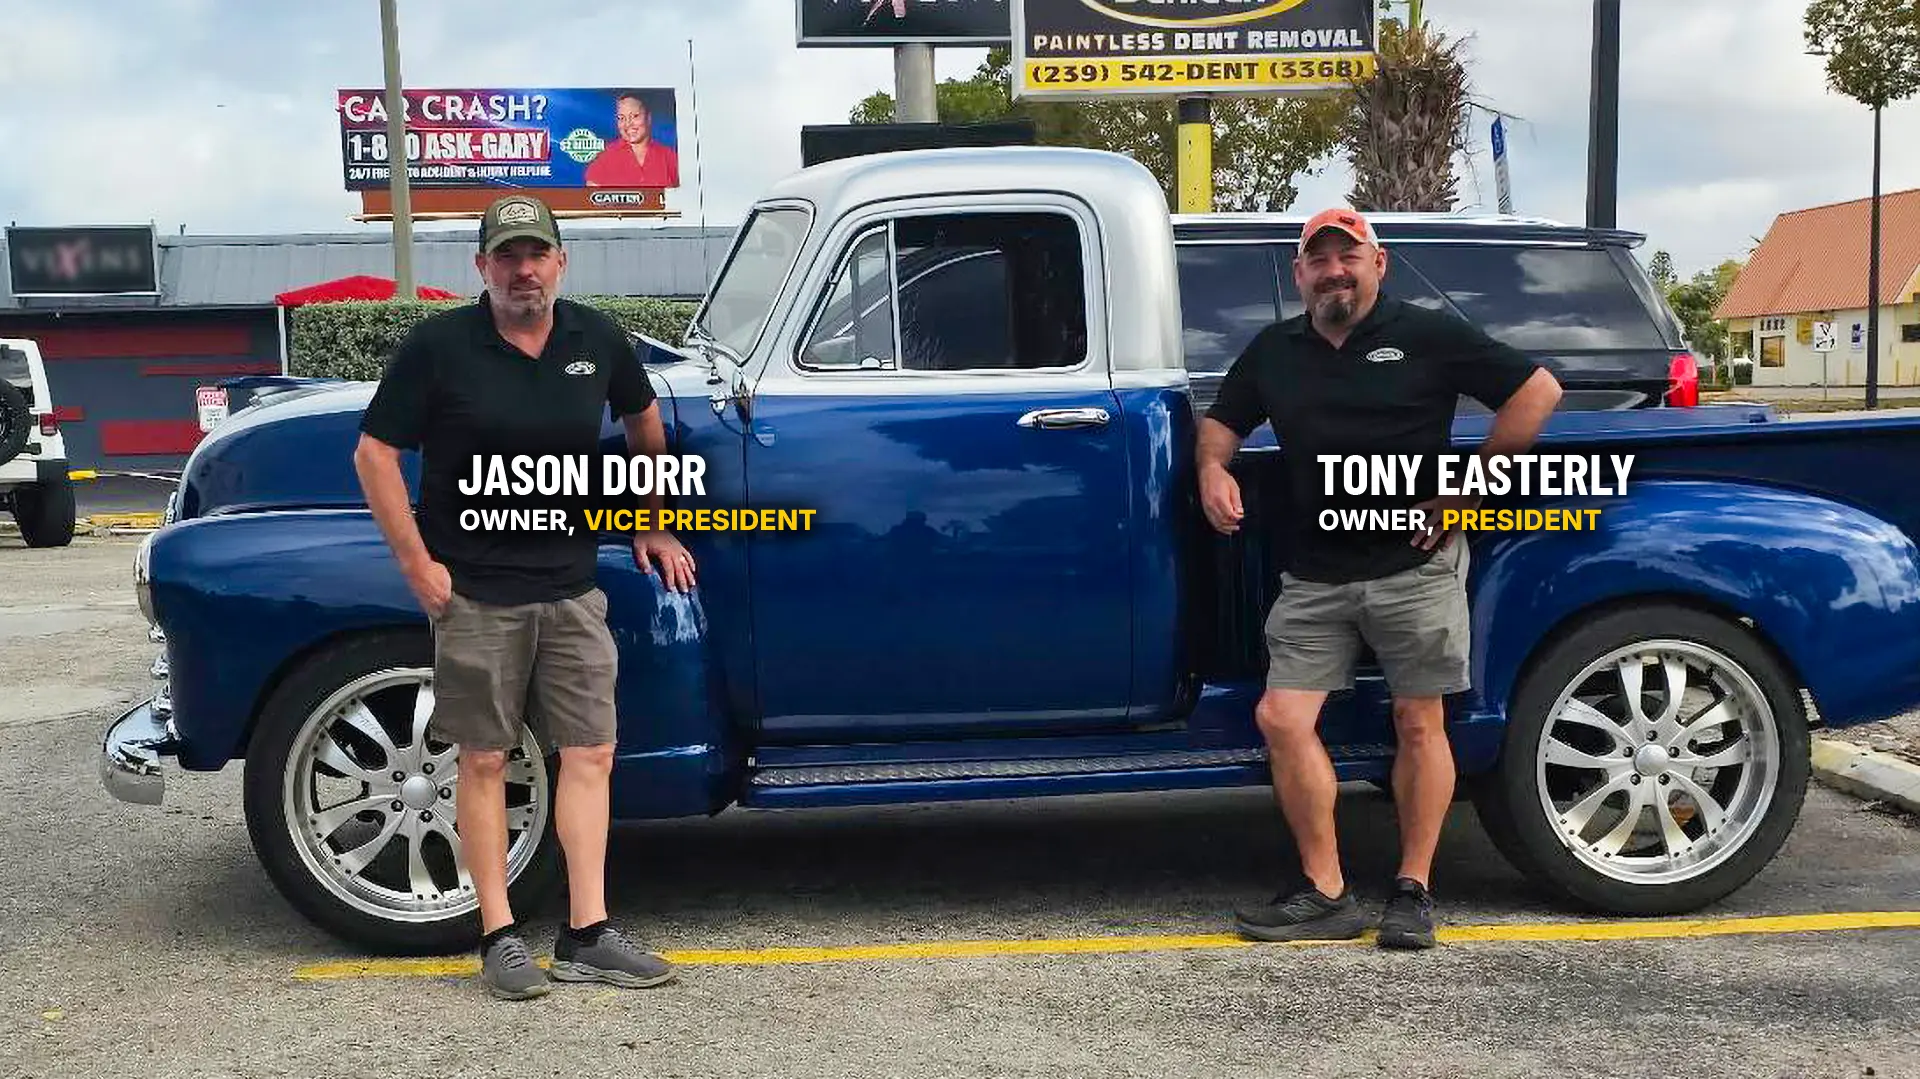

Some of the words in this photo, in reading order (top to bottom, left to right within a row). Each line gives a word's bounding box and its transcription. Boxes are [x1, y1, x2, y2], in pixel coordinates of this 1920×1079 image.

[1033, 32, 1166, 51] PAINTLESS
[1173, 31, 1239, 50] DENT
[1247, 29, 1363, 49] REMOVAL
[1032, 65, 1110, 84] (239)
[1121, 62, 1259, 82] 542-DENT
[1269, 59, 1364, 80] (3368)
[344, 95, 412, 122] CAR
[421, 94, 548, 121] CRASH?
[349, 131, 420, 162] 1-80
[424, 130, 545, 160] ASK-GARY
[594, 194, 641, 203] CARTER
